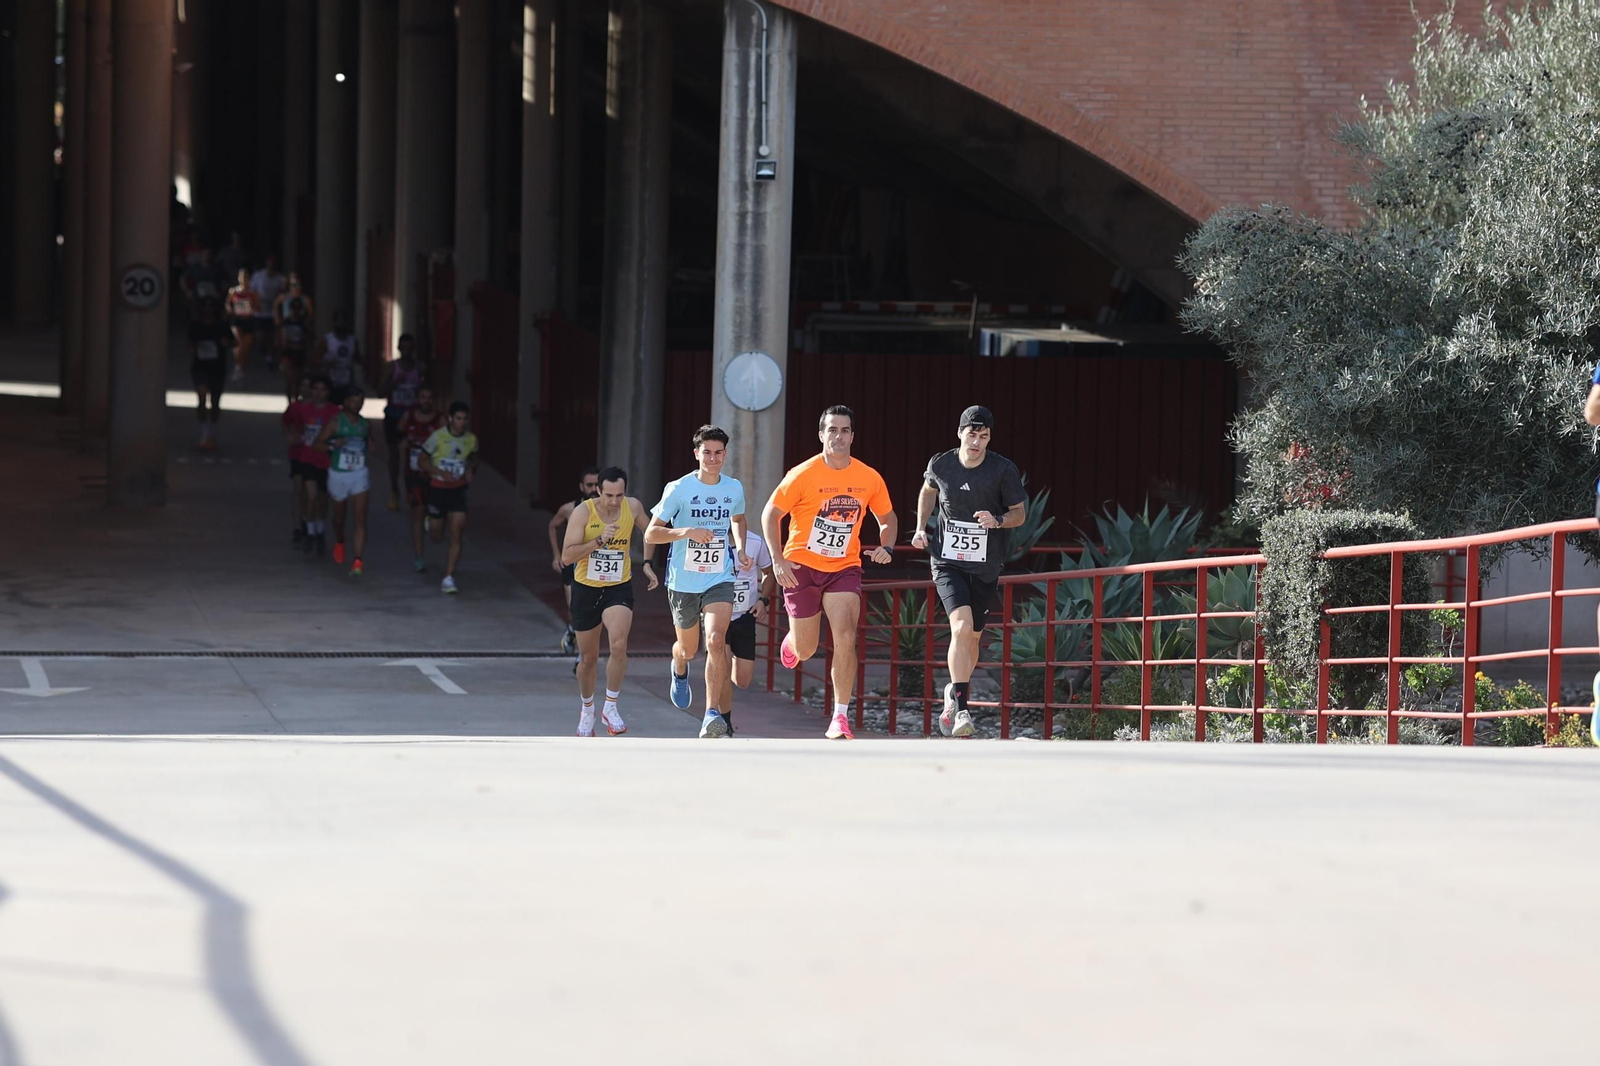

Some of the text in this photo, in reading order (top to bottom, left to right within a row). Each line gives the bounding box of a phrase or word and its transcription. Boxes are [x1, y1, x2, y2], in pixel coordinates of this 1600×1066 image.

[124, 276, 155, 297] 20
[690, 505, 730, 520] nerja
[815, 521, 833, 532] UMA
[947, 525, 965, 534] UMA
[816, 531, 846, 548] 218
[951, 534, 981, 551] 255
[692, 550, 719, 563] 216
[594, 560, 619, 573] 534
